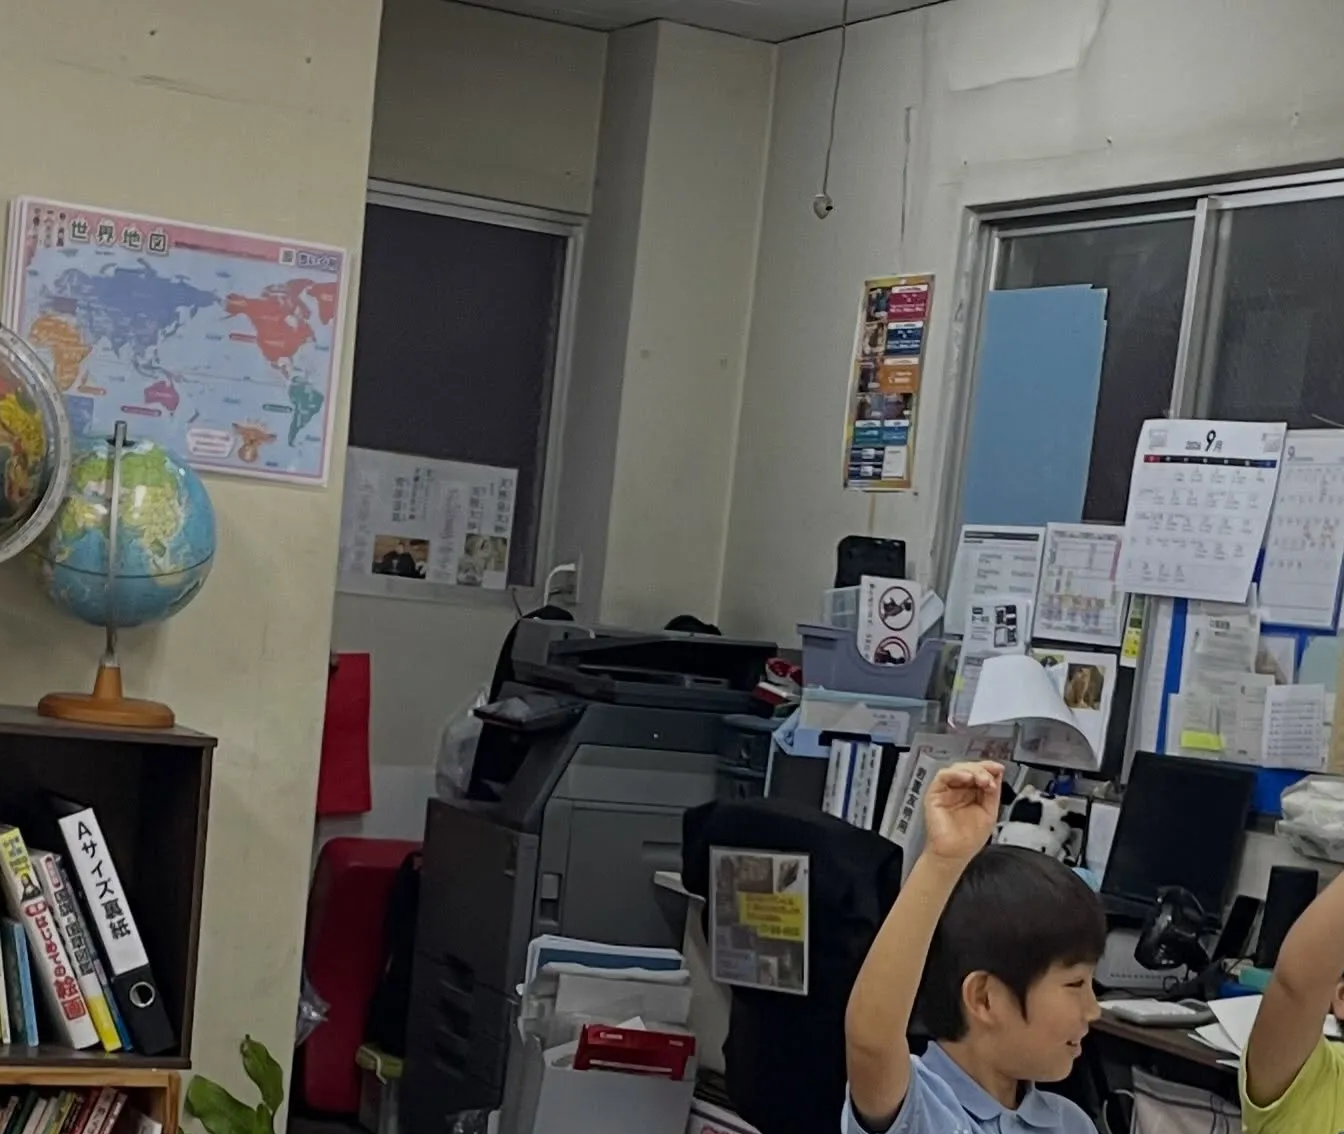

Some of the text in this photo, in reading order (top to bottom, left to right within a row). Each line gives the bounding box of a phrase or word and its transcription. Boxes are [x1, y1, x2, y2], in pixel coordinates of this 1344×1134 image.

[70, 218, 168, 256] 世界地図
[76, 820, 132, 940] Aサイズ裏紙
